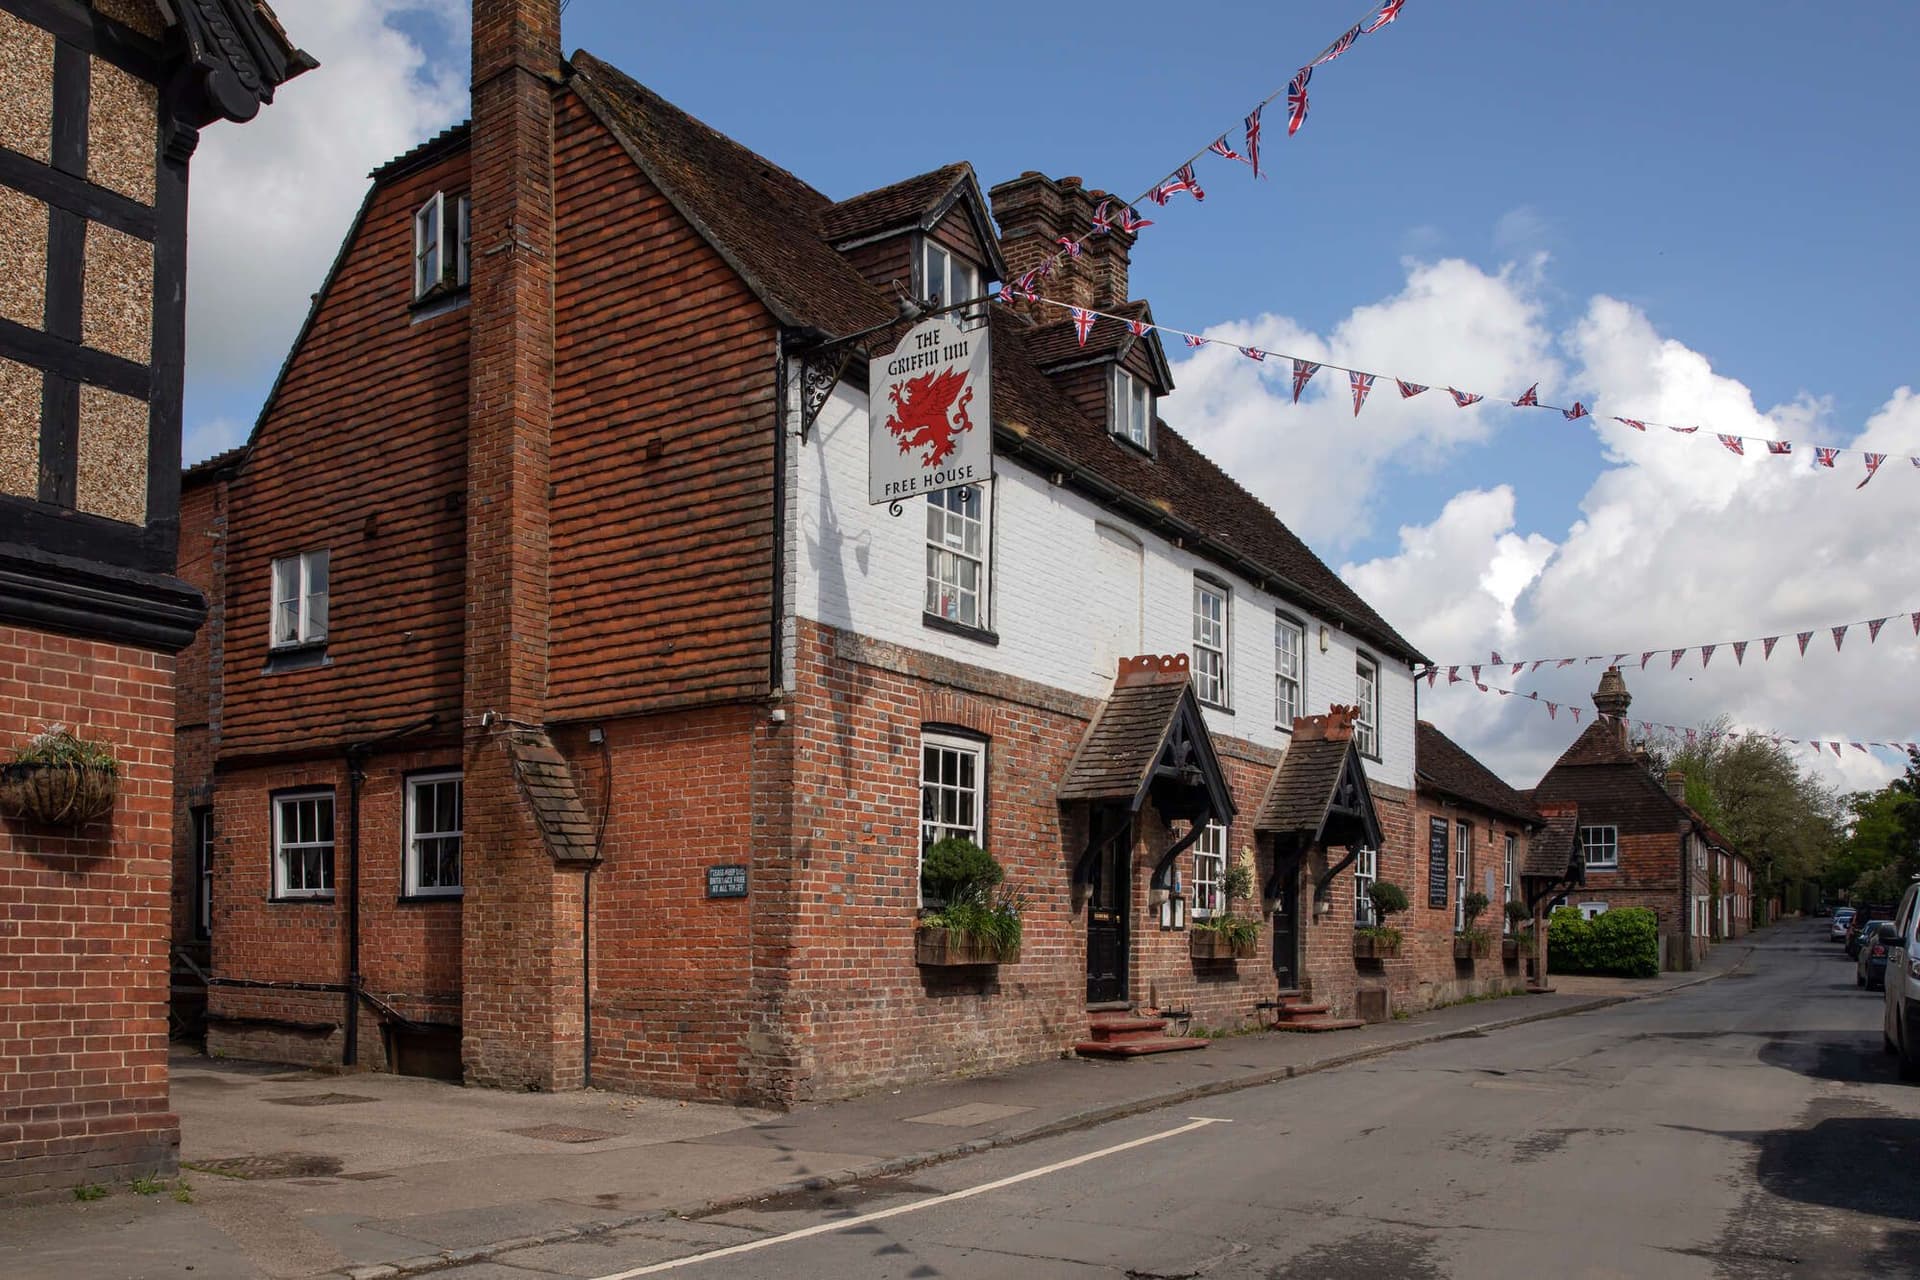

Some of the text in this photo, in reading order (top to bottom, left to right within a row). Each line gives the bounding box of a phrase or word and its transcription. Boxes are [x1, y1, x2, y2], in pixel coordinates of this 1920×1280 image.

[915, 329, 941, 349] THE
[885, 465, 974, 496] FREE HOUSE
